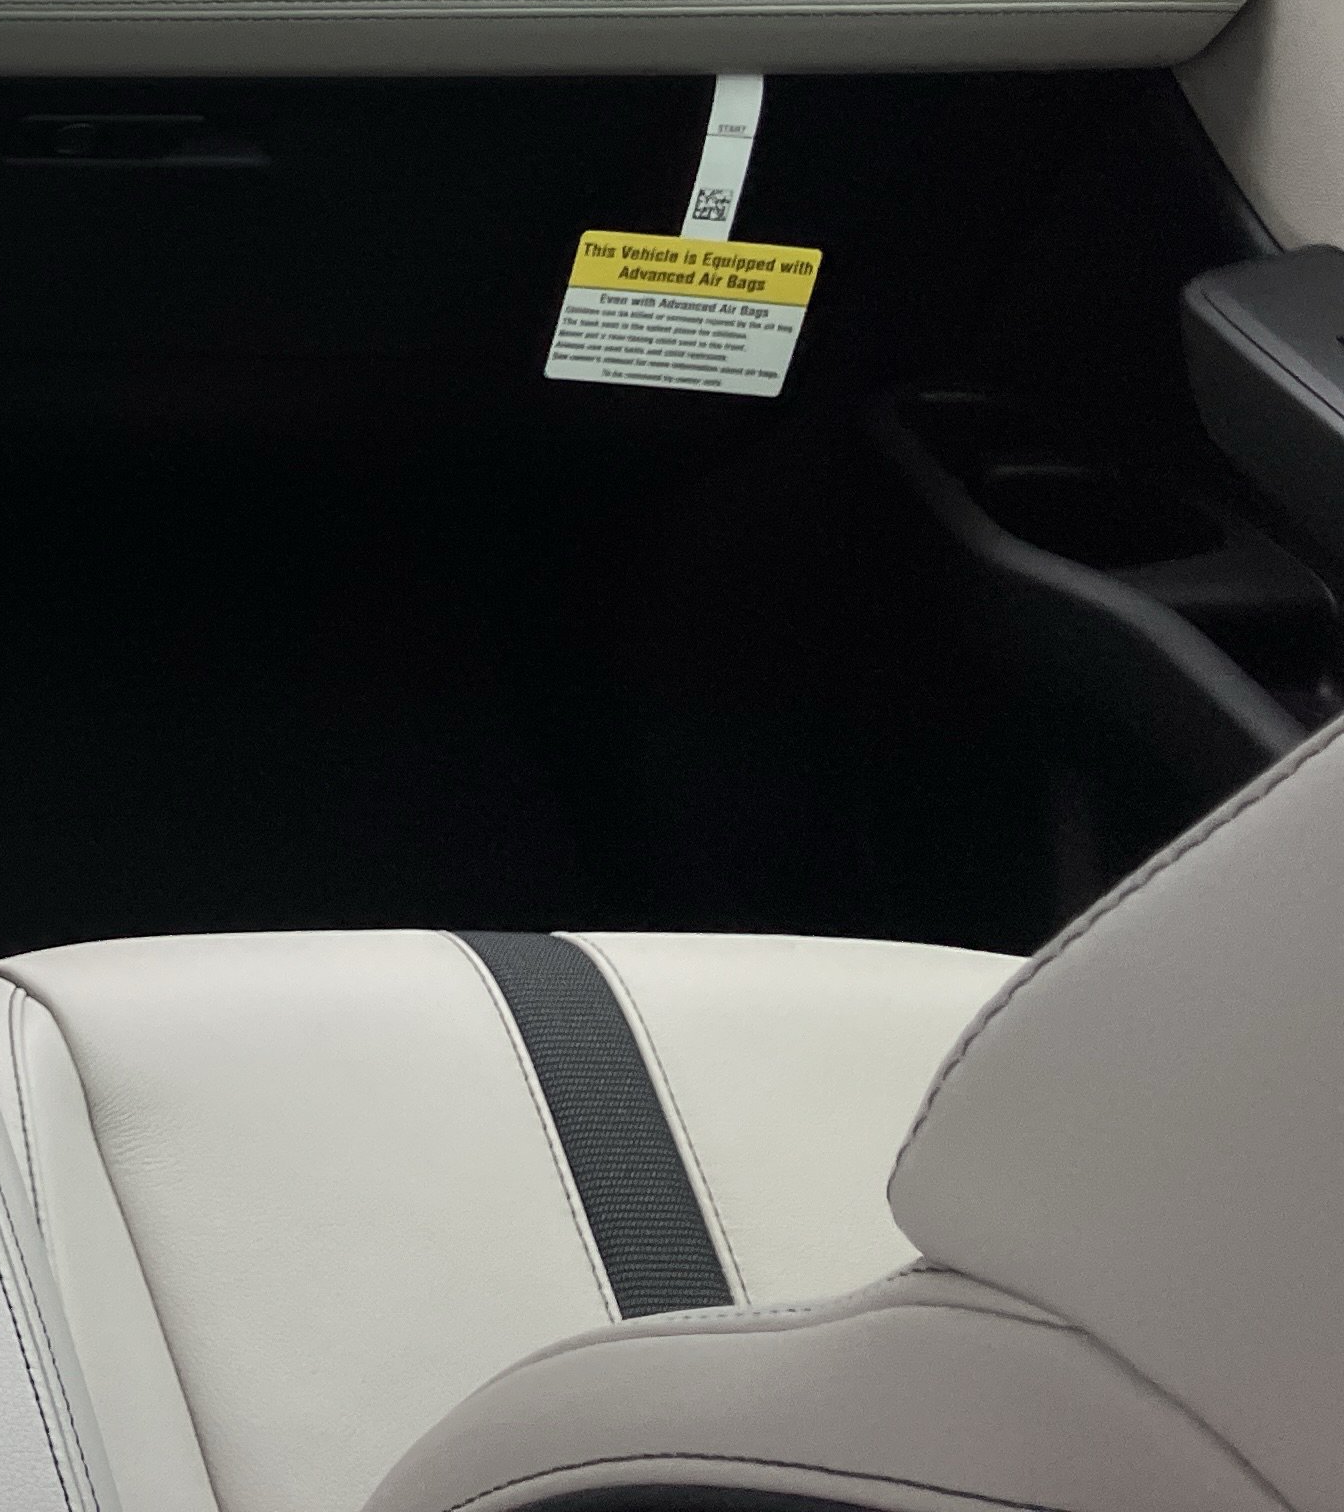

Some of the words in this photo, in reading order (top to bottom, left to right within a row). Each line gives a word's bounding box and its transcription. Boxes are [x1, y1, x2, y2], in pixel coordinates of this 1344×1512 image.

[584, 241, 616, 258] This
[622, 245, 679, 263] Vehicle
[683, 249, 697, 265] is
[702, 251, 776, 273] Equipped
[780, 260, 814, 276] with
[618, 265, 696, 285] Advanced
[699, 271, 723, 287] Air
[727, 274, 766, 292] Bags
[600, 293, 628, 305] Even
[631, 297, 656, 308] with
[658, 298, 717, 313] Advanced
[719, 303, 737, 315] Air
[740, 305, 769, 319] Bags
